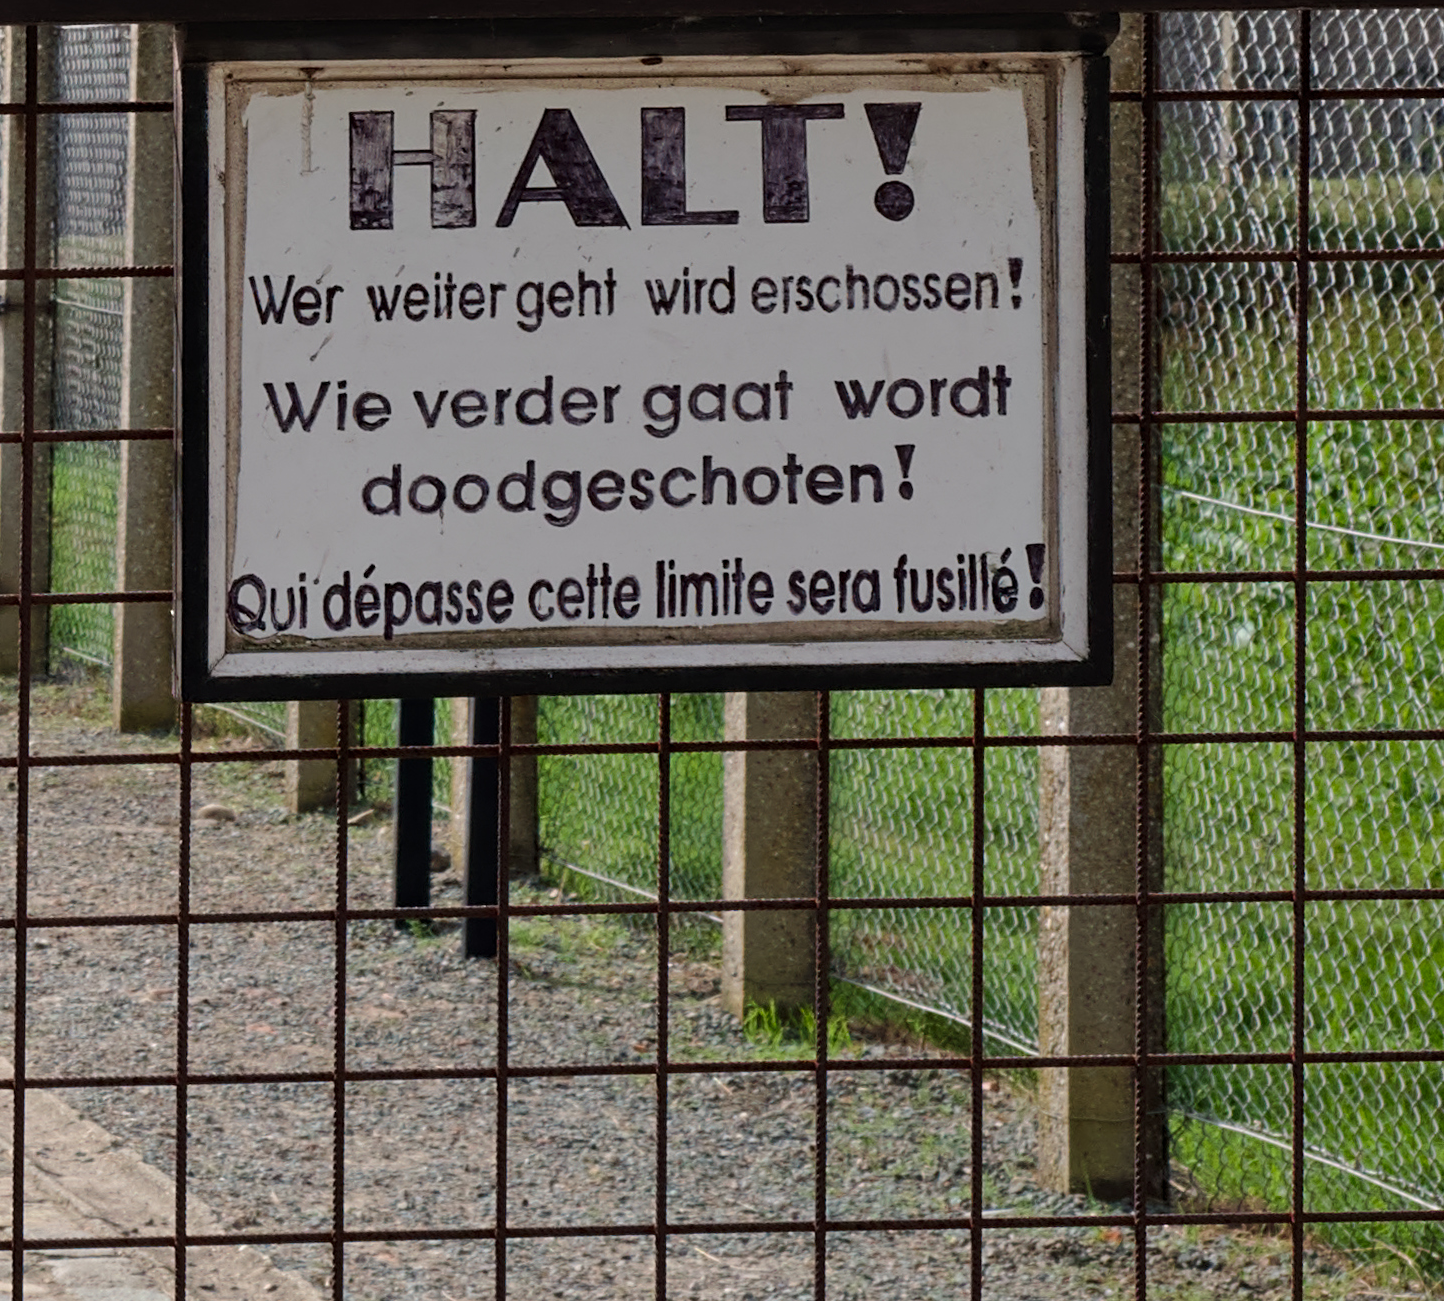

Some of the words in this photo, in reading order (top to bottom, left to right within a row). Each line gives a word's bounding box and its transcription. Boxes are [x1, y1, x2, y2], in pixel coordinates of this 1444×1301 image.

[349, 102, 922, 231] HALT!
[247, 274, 345, 326] Wer
[366, 270, 507, 323] weiter
[515, 267, 619, 333] geht
[644, 265, 736, 318] wird
[750, 257, 1025, 315] erschossen!
[262, 378, 392, 434] Wie
[412, 375, 622, 430] verder
[642, 369, 794, 439] gaat
[833, 364, 1013, 420] wordt
[361, 443, 917, 528] doodgeschoten!
[226, 570, 309, 637] Qui
[322, 562, 515, 641] dépasse
[527, 562, 641, 621] cette
[655, 555, 775, 619] limite
[786, 568, 882, 616] sera
[892, 543, 1046, 614] fusillé!
